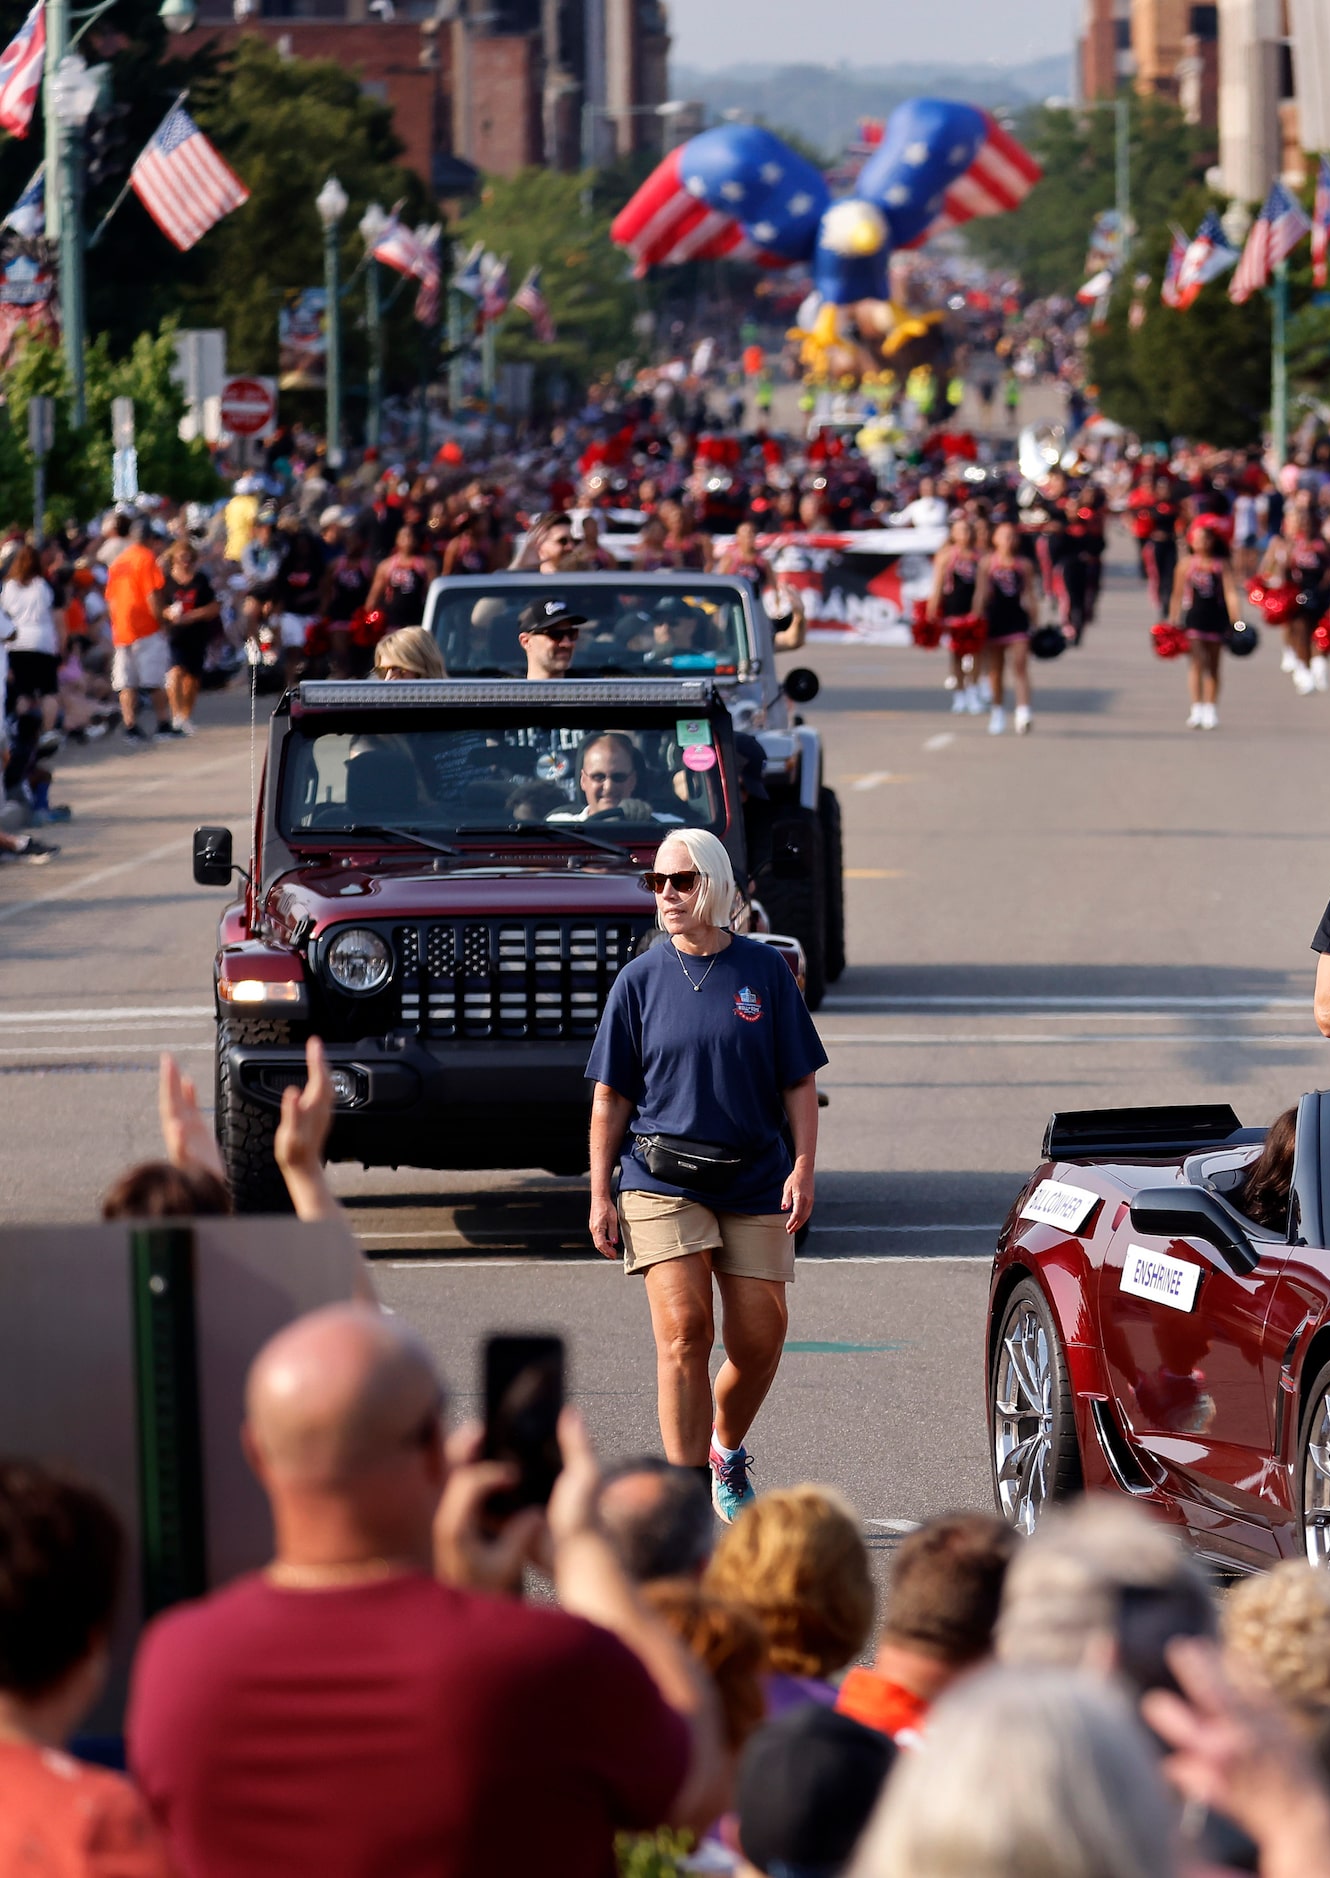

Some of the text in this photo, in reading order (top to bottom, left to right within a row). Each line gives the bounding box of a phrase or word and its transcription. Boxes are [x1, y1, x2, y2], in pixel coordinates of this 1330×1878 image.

[1029, 1188, 1083, 1220] BILL COWHER
[1133, 1258, 1184, 1296] ENSHRINEE
